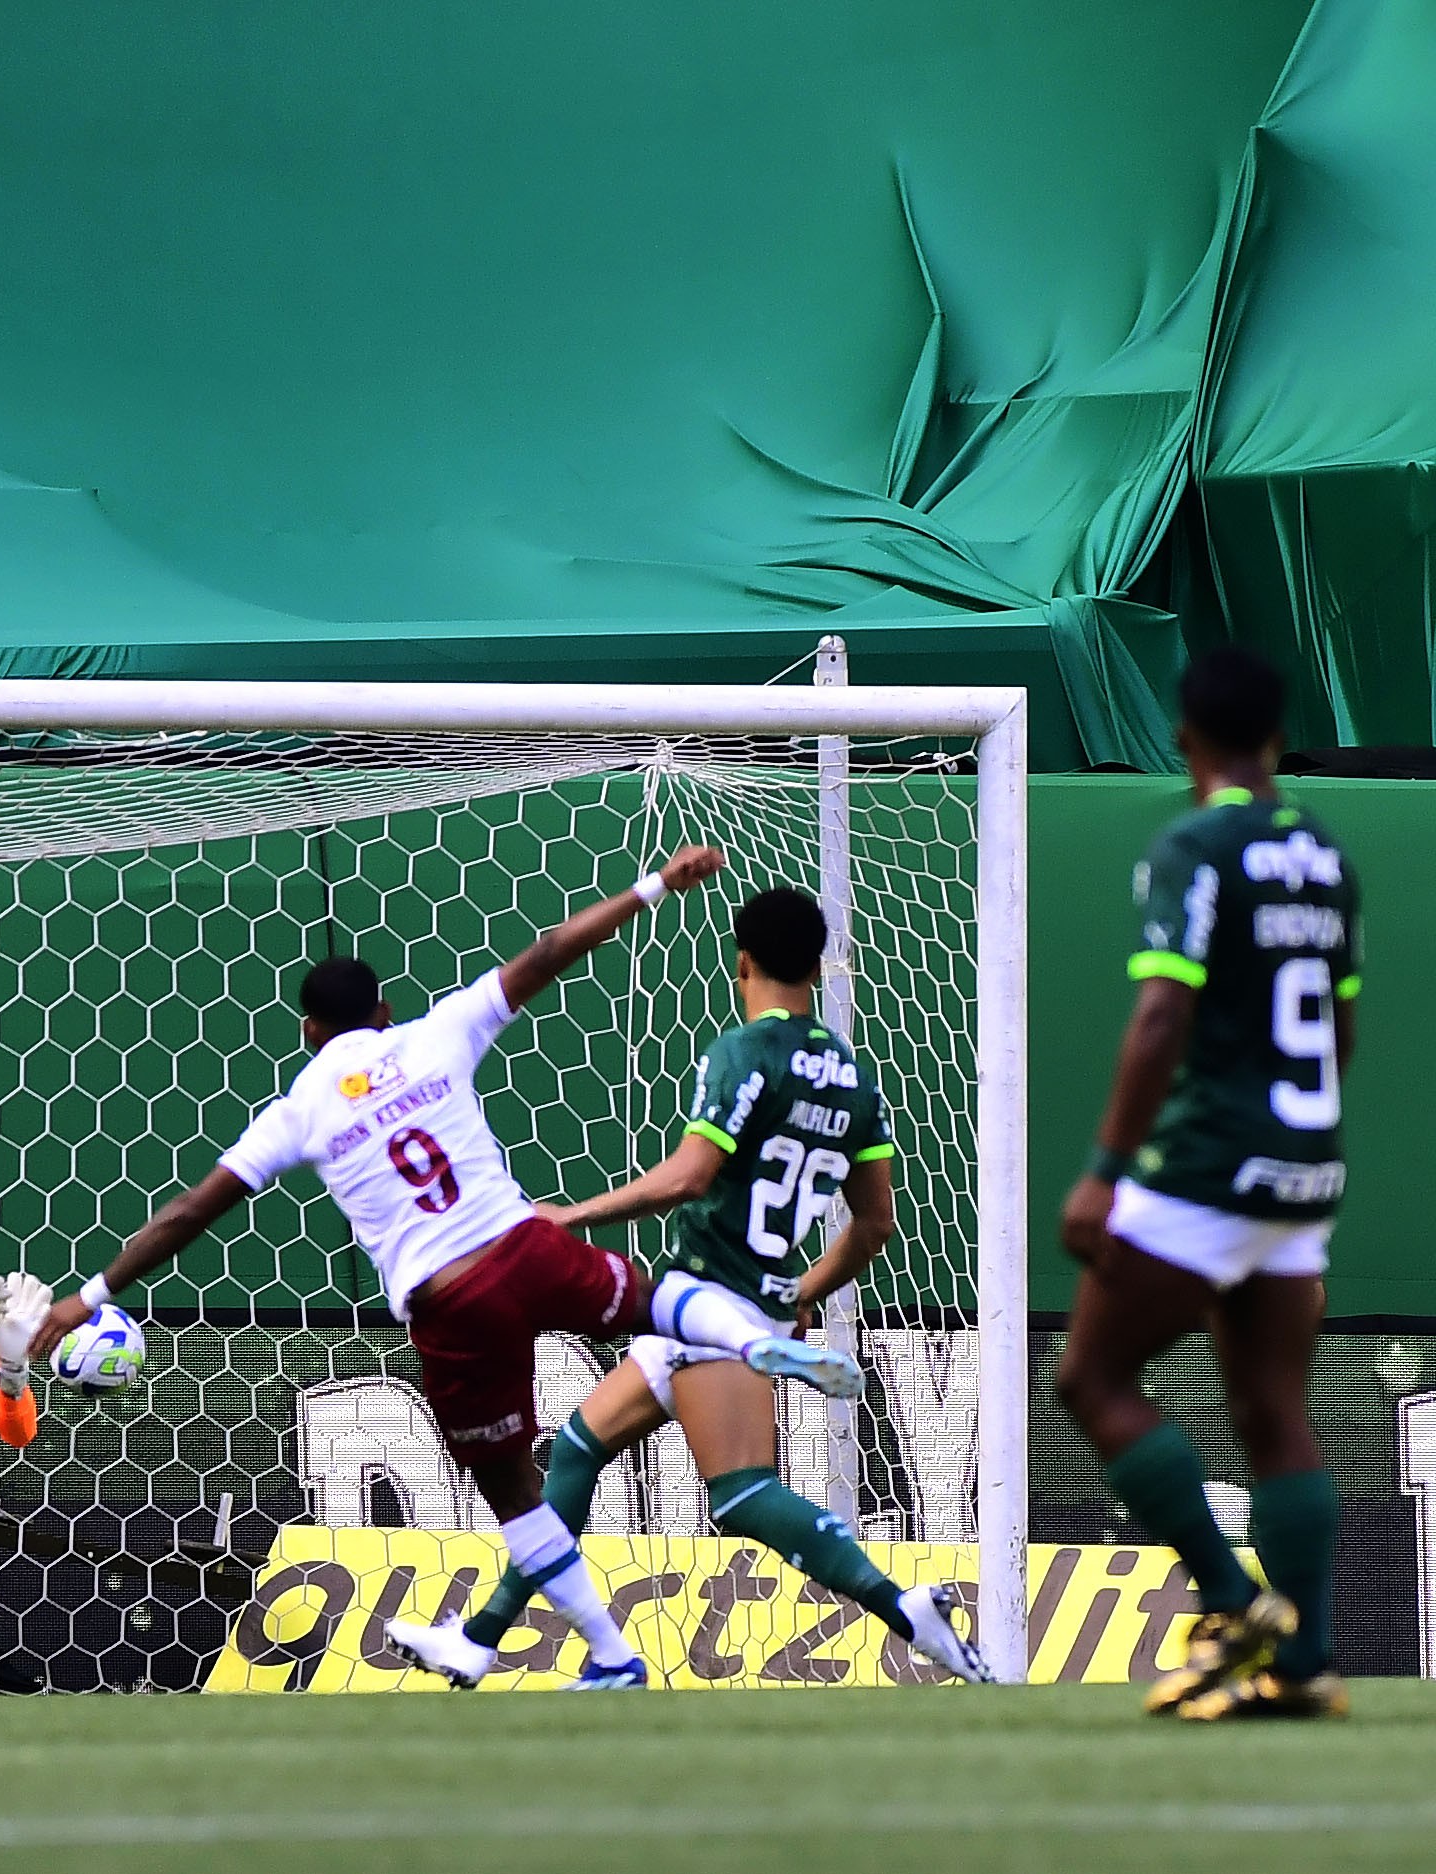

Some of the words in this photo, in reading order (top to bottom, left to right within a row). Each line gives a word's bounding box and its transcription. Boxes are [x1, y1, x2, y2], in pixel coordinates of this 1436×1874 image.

[1269, 956, 1342, 1130] 9
[327, 1118, 372, 1159] JOHN
[372, 1073, 452, 1127] KENNEDY
[387, 1126, 460, 1214] 9
[746, 1134, 851, 1260] 26
